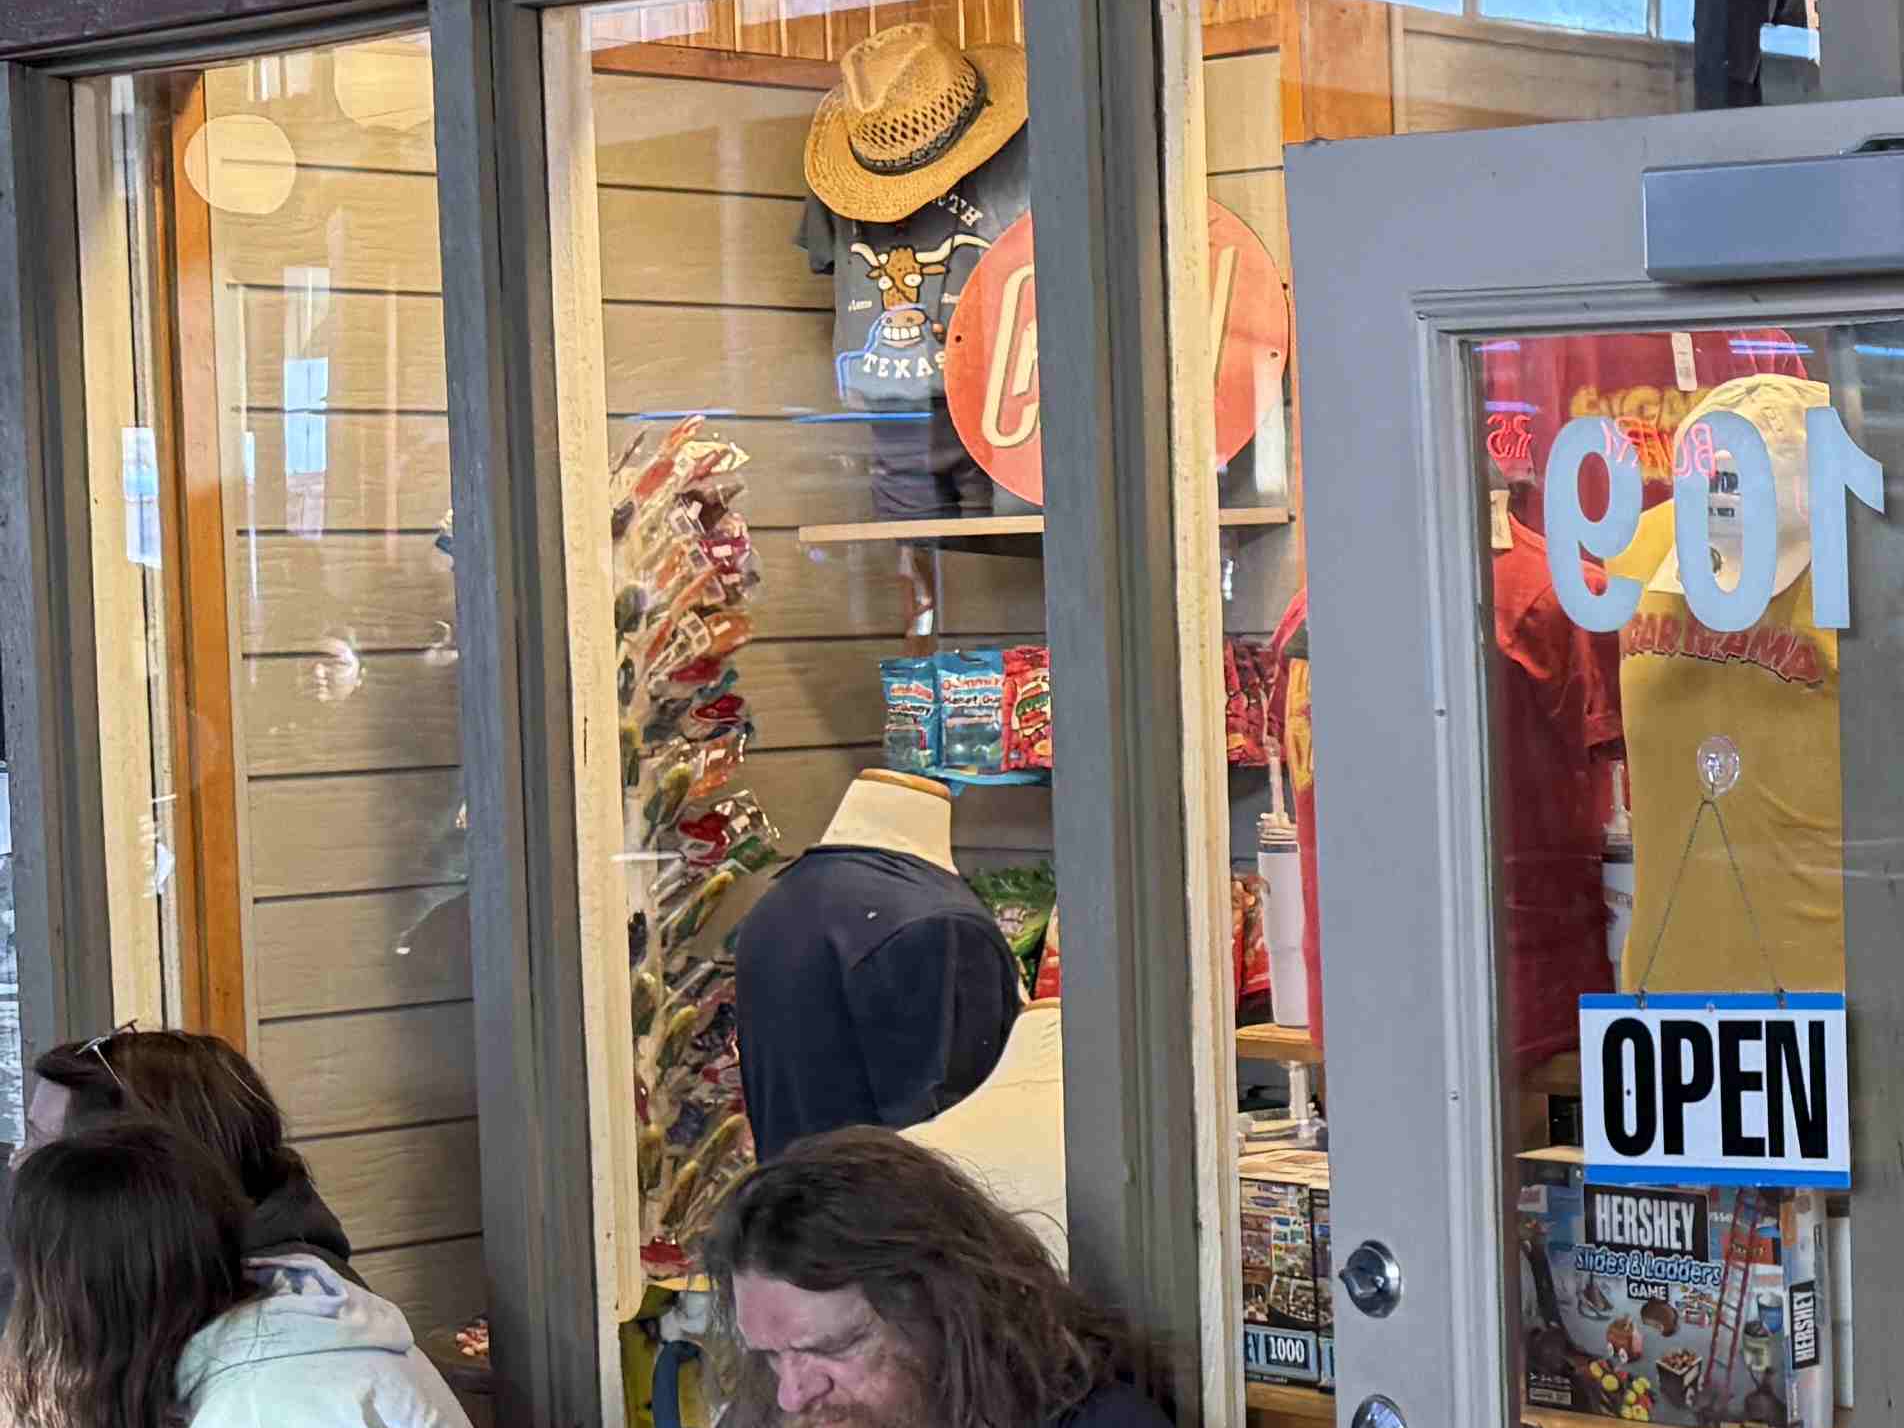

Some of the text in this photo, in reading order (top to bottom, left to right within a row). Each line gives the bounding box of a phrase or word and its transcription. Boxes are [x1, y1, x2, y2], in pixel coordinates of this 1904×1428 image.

[1601, 1016, 1828, 1159] OPEN
[1594, 1193, 1696, 1251] HERSHEY
[1628, 1282, 1667, 1301] GAME
[1269, 1336, 1305, 1364] 1000
[1790, 1289, 1817, 1364] HERSHEY
